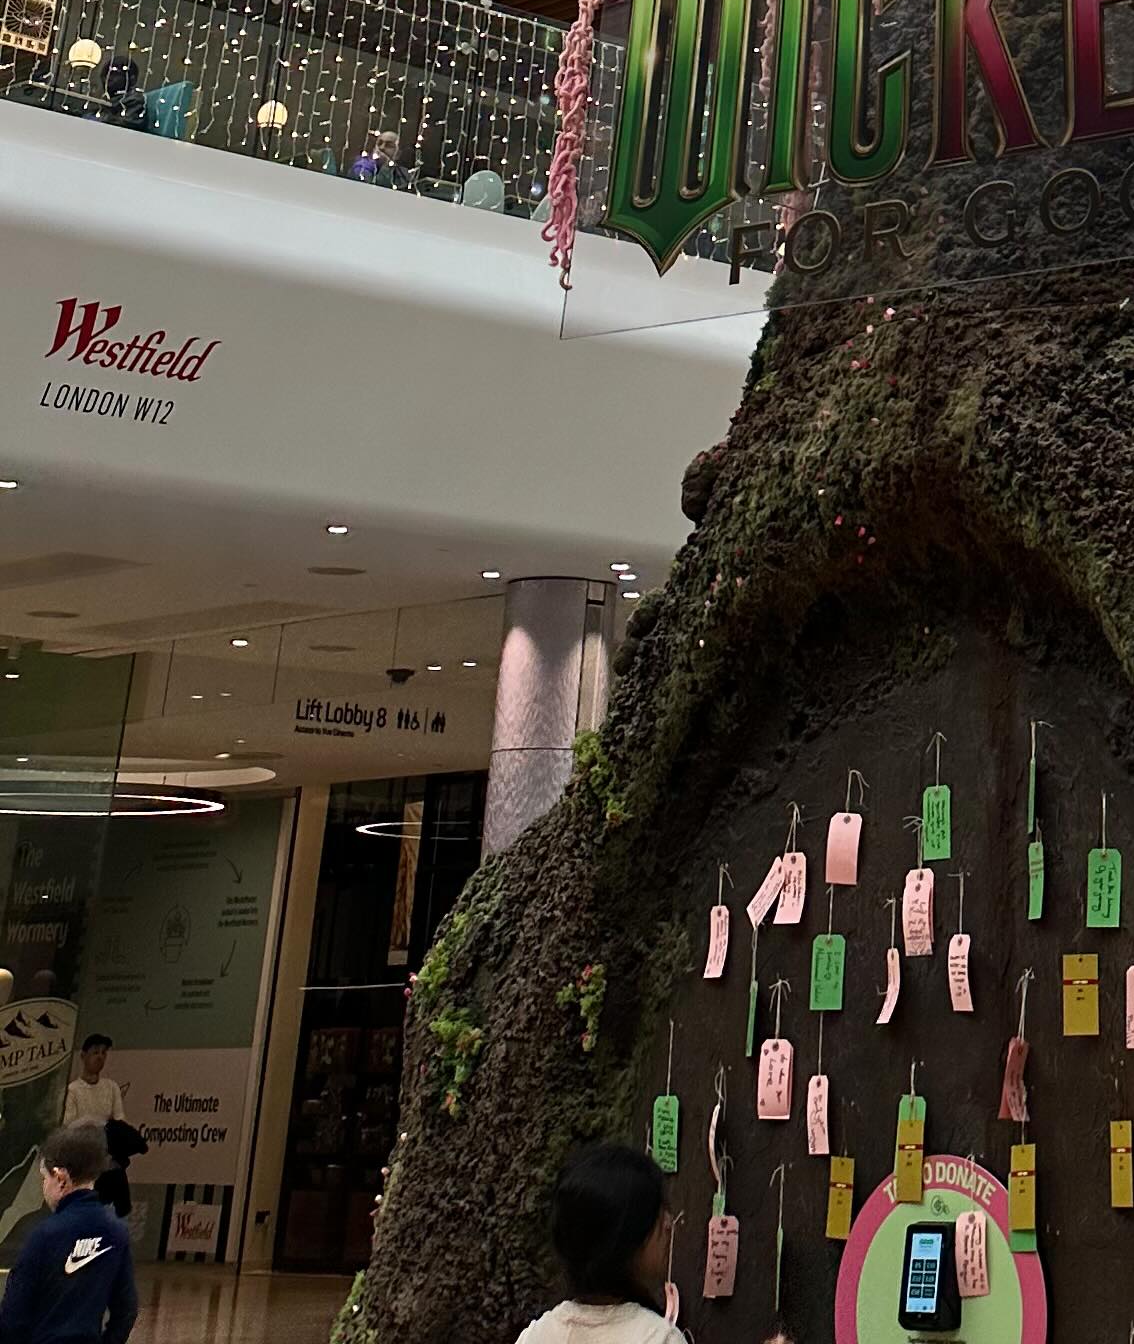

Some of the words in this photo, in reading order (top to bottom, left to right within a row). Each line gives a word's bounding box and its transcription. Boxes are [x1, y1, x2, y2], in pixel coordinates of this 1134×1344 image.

[728, 198, 915, 286] FOR
[44, 297, 223, 382] Westfield
[39, 382, 130, 418] LONDON
[133, 396, 175, 425] W12
[296, 698, 323, 723] Lift
[325, 701, 374, 733] Lobby
[376, 707, 388, 729] 8
[13, 874, 77, 905] Westfield
[7, 918, 69, 949] Wormery
[27, 1037, 67, 1062] TALA
[154, 1092, 173, 1113] The
[174, 1092, 220, 1113] Ultimate
[201, 1123, 229, 1143] Crew
[935, 1161, 997, 1205] DONATE
[71, 1236, 103, 1258] NIKE
